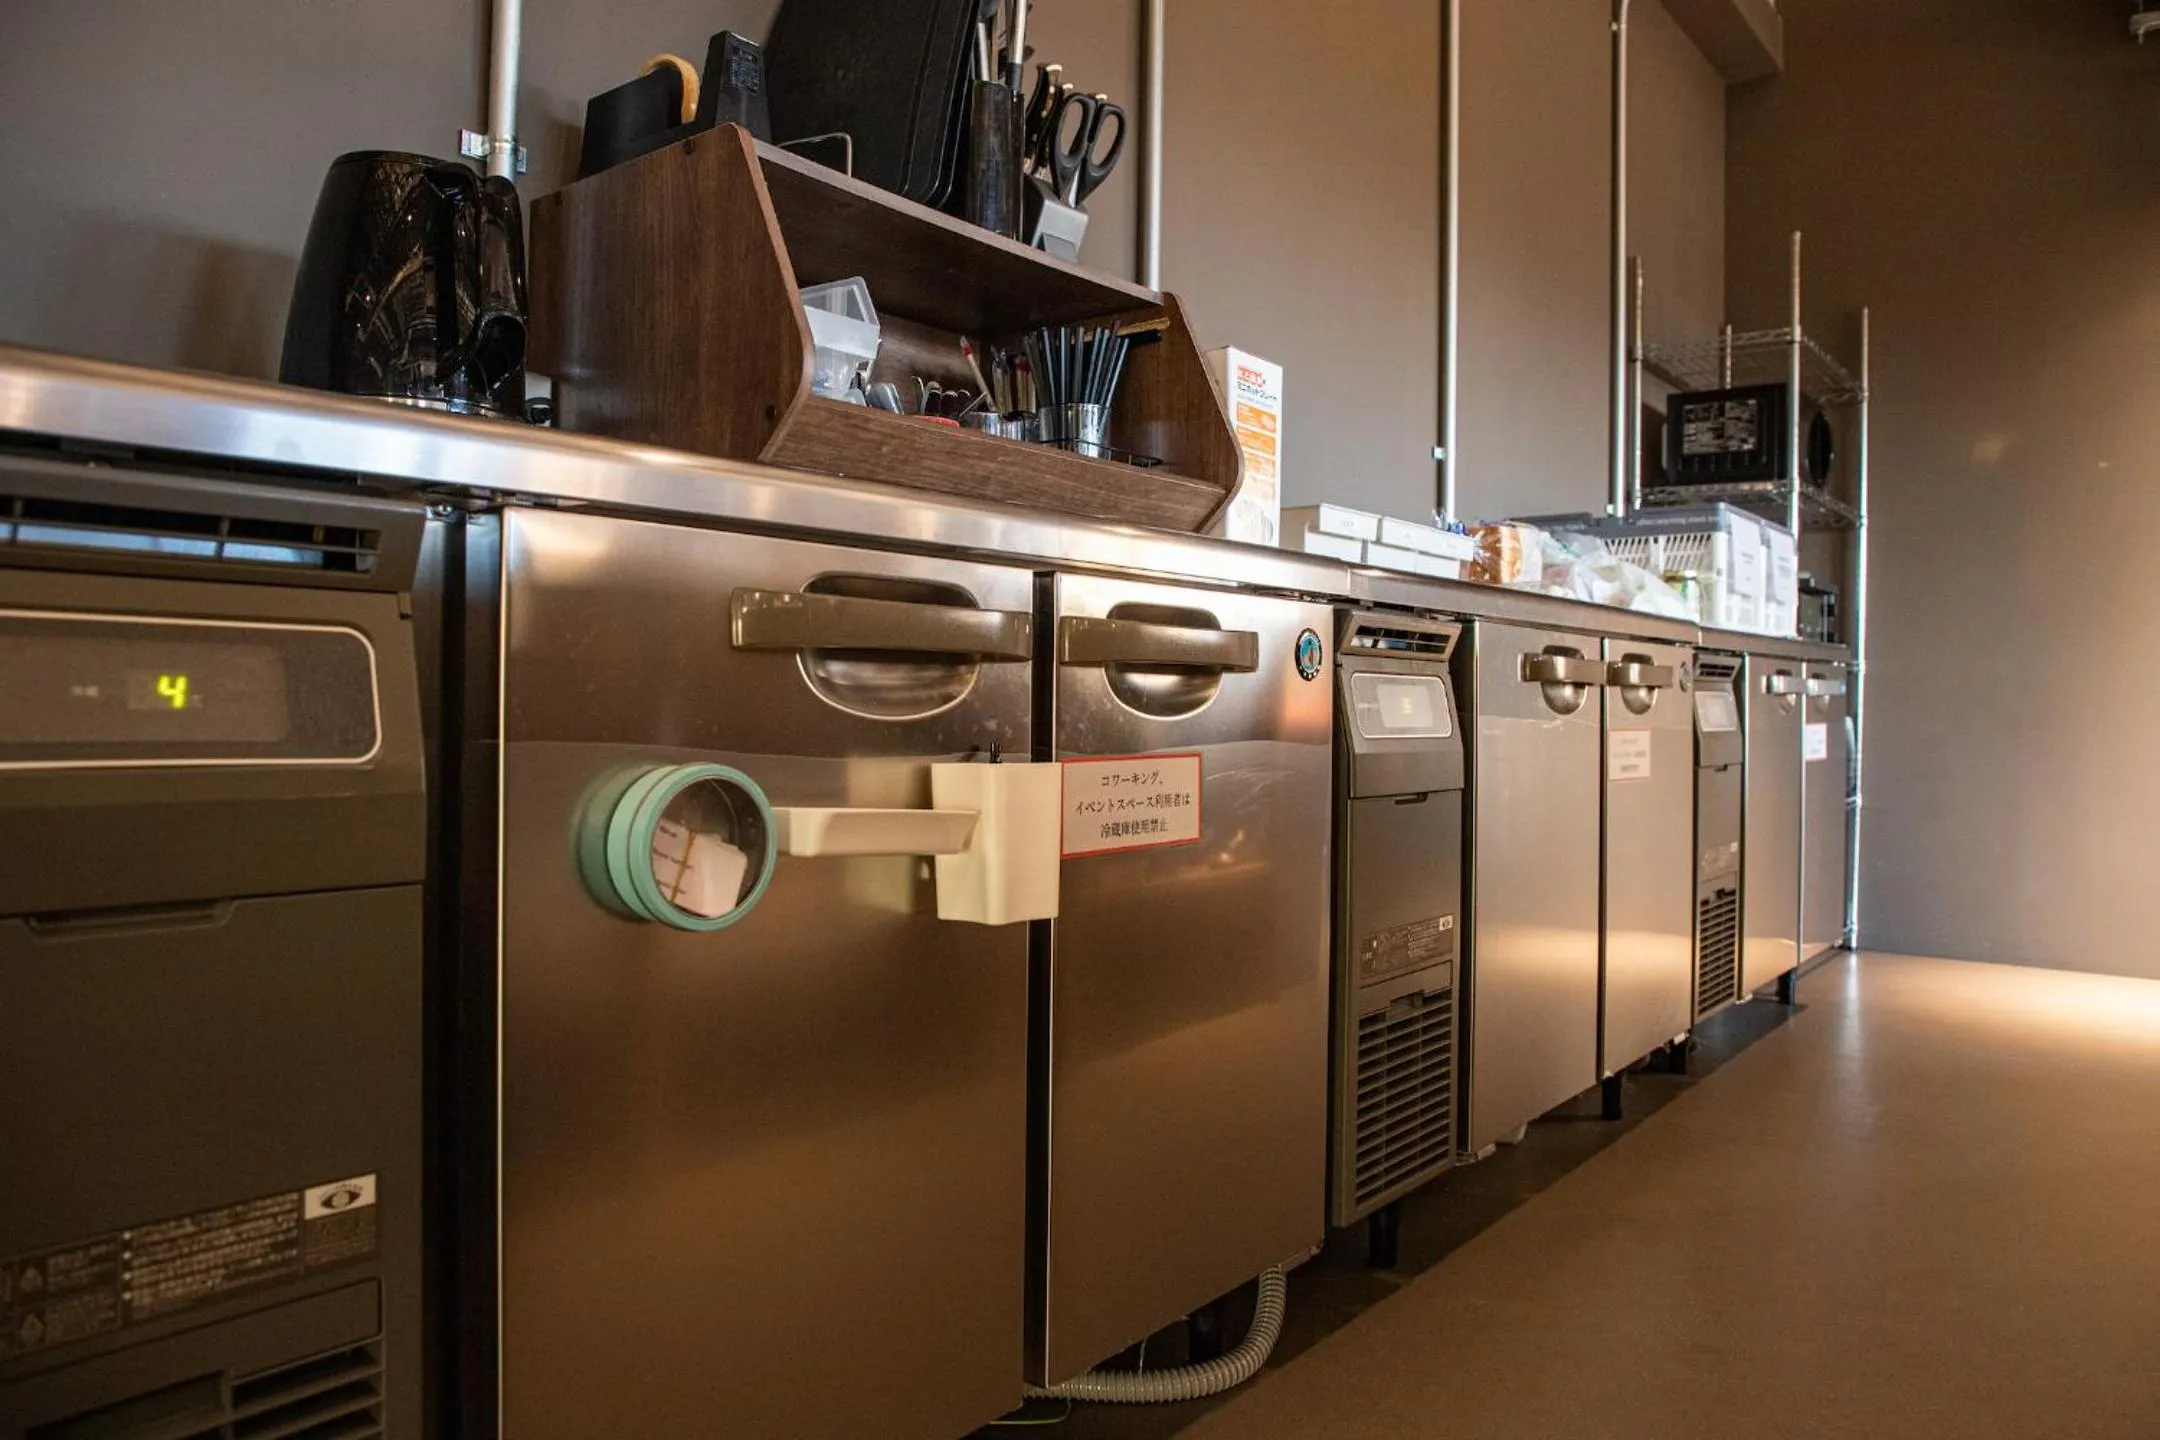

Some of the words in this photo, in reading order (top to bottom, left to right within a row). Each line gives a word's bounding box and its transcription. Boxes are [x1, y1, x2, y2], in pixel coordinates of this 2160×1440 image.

[158, 674, 188, 709] 4
[1101, 770, 1163, 787] コワーキング、
[1075, 792, 1191, 816] イベントスペース利用者は
[1100, 818, 1168, 838] 冷蔵庫使用禁止
